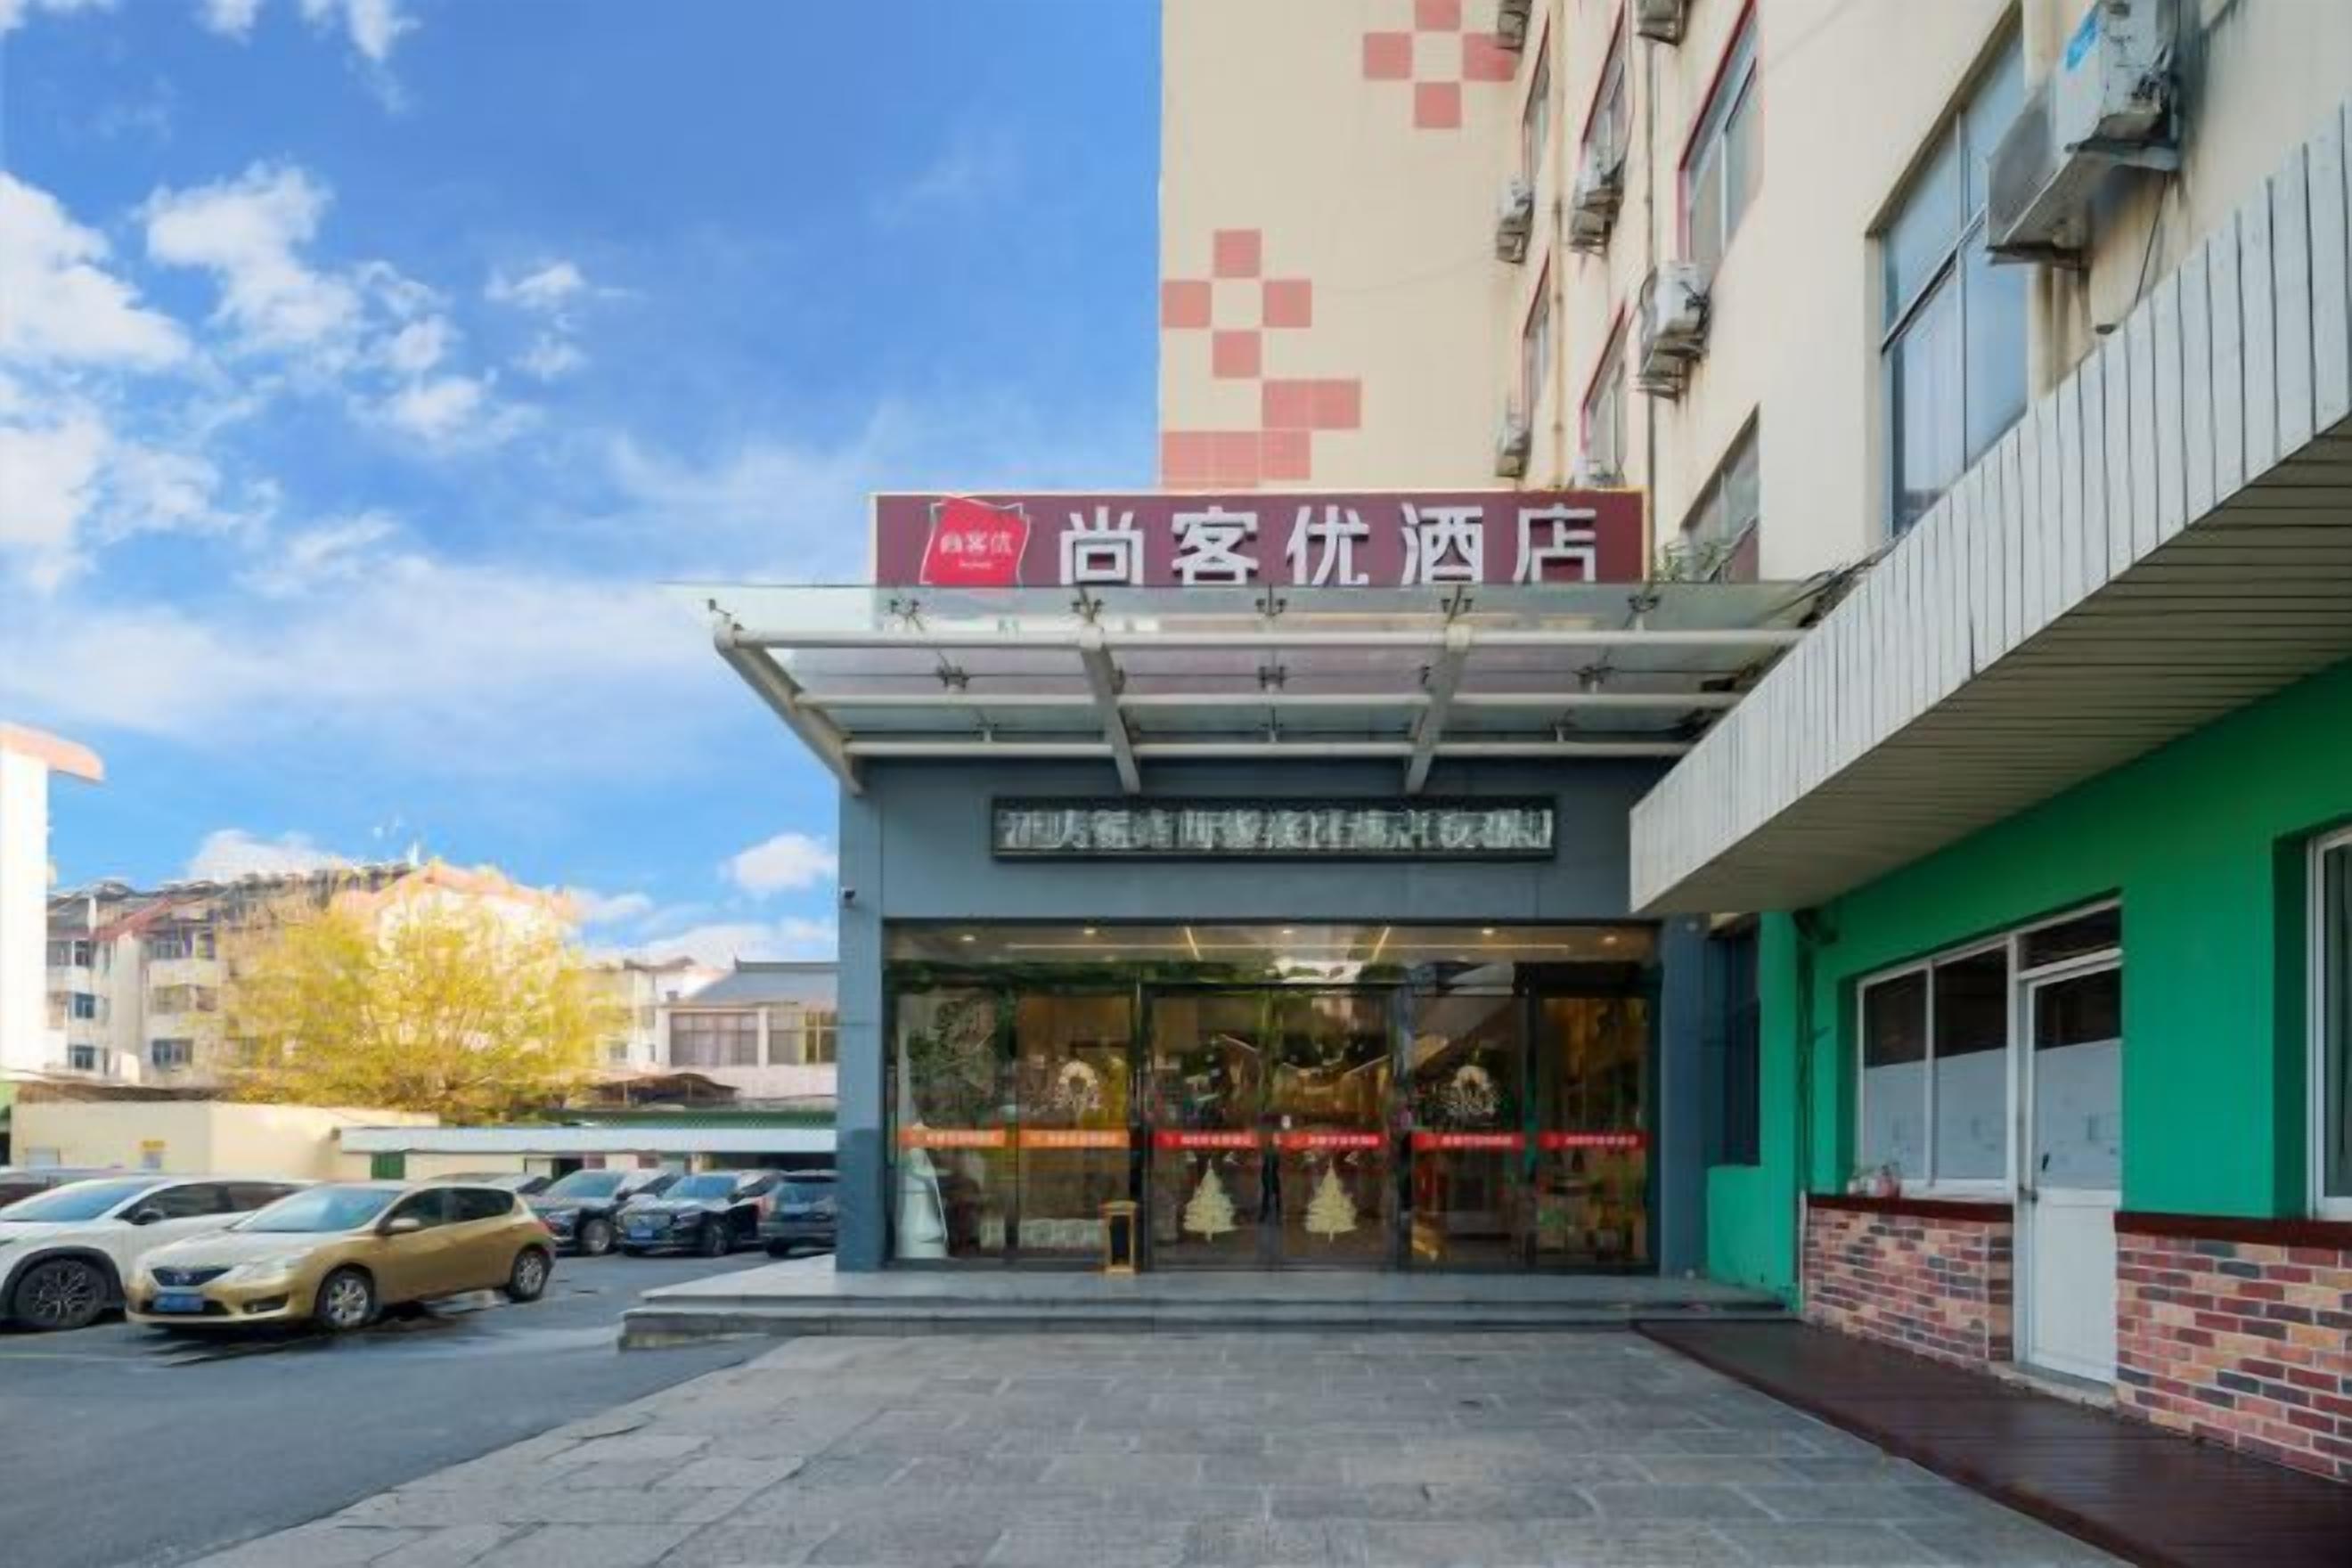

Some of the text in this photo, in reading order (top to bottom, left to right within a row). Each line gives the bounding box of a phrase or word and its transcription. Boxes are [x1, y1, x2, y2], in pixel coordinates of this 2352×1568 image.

[1059, 502, 1597, 585] 尚客优酒店
